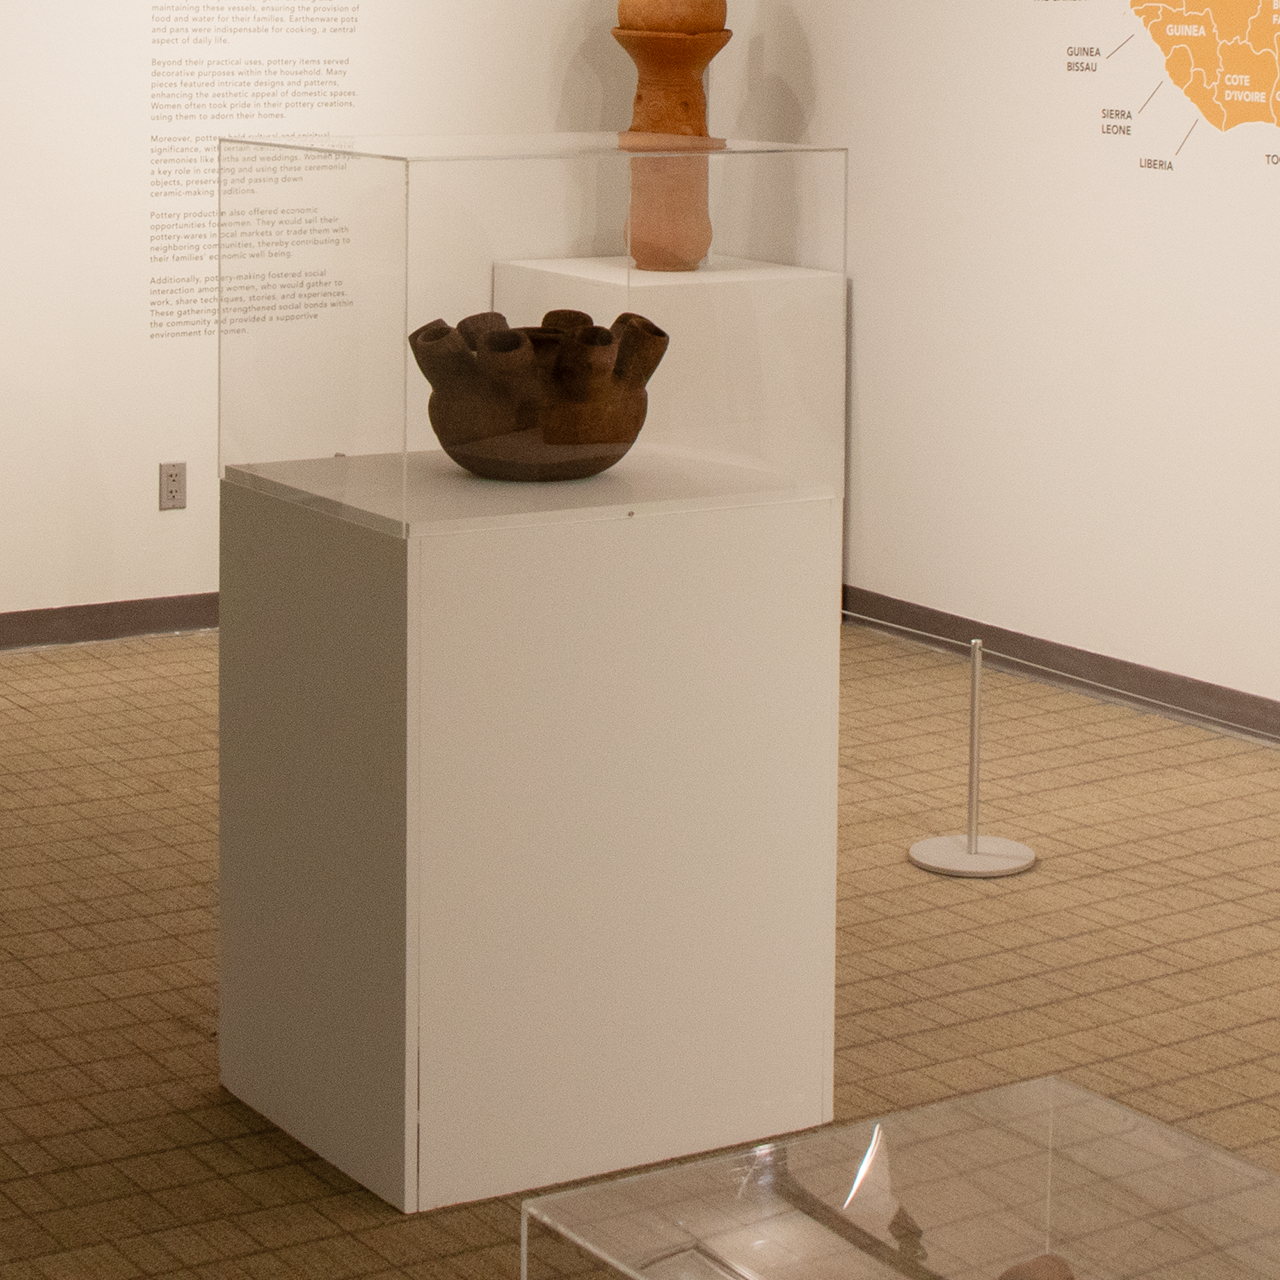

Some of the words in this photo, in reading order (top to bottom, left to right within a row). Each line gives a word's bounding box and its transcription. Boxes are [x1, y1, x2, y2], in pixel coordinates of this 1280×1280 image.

[151, 4, 200, 14] maintaining
[202, 3, 224, 12] these
[260, 4, 295, 14] ensuring
[297, 3, 310, 12] the
[312, 4, 349, 14] provision
[351, 3, 360, 12] of
[151, 14, 171, 22] food
[173, 14, 189, 22] and
[191, 14, 214, 22] water
[217, 14, 228, 22] for
[231, 14, 250, 22] their
[288, 14, 338, 22] Earthenware
[340, 15, 359, 24] pots
[1166, 24, 1205, 36] GUINEA
[151, 36, 178, 46] aspect
[181, 36, 189, 44] of
[192, 36, 211, 46] daily
[1067, 47, 1100, 56] GUINEA
[151, 57, 182, 68] Beyond
[184, 57, 204, 65] their
[206, 57, 241, 67] practical
[266, 57, 296, 67] pottery
[299, 57, 320, 65] items
[323, 56, 350, 65] served
[1067, 62, 1097, 72] BISSAU
[151, 68, 195, 76] decorative
[197, 70, 234, 78] purposes
[237, 67, 261, 76] within
[264, 67, 277, 76] the
[325, 67, 347, 77] Many
[151, 80, 177, 90] pieces
[179, 79, 215, 87] featured
[217, 79, 251, 87] intricate
[253, 78, 284, 89] designs
[287, 78, 301, 86] and
[1225, 75, 1249, 86] COTE
[1225, 90, 1266, 102] D'IVOIRE
[150, 112, 173, 122] using
[175, 111, 196, 120] them
[210, 111, 234, 119] adorn
[236, 110, 255, 119] their
[1102, 109, 1132, 119] SIERRA
[1102, 125, 1130, 135] LEONE
[1140, 159, 1173, 170] LIBERIA
